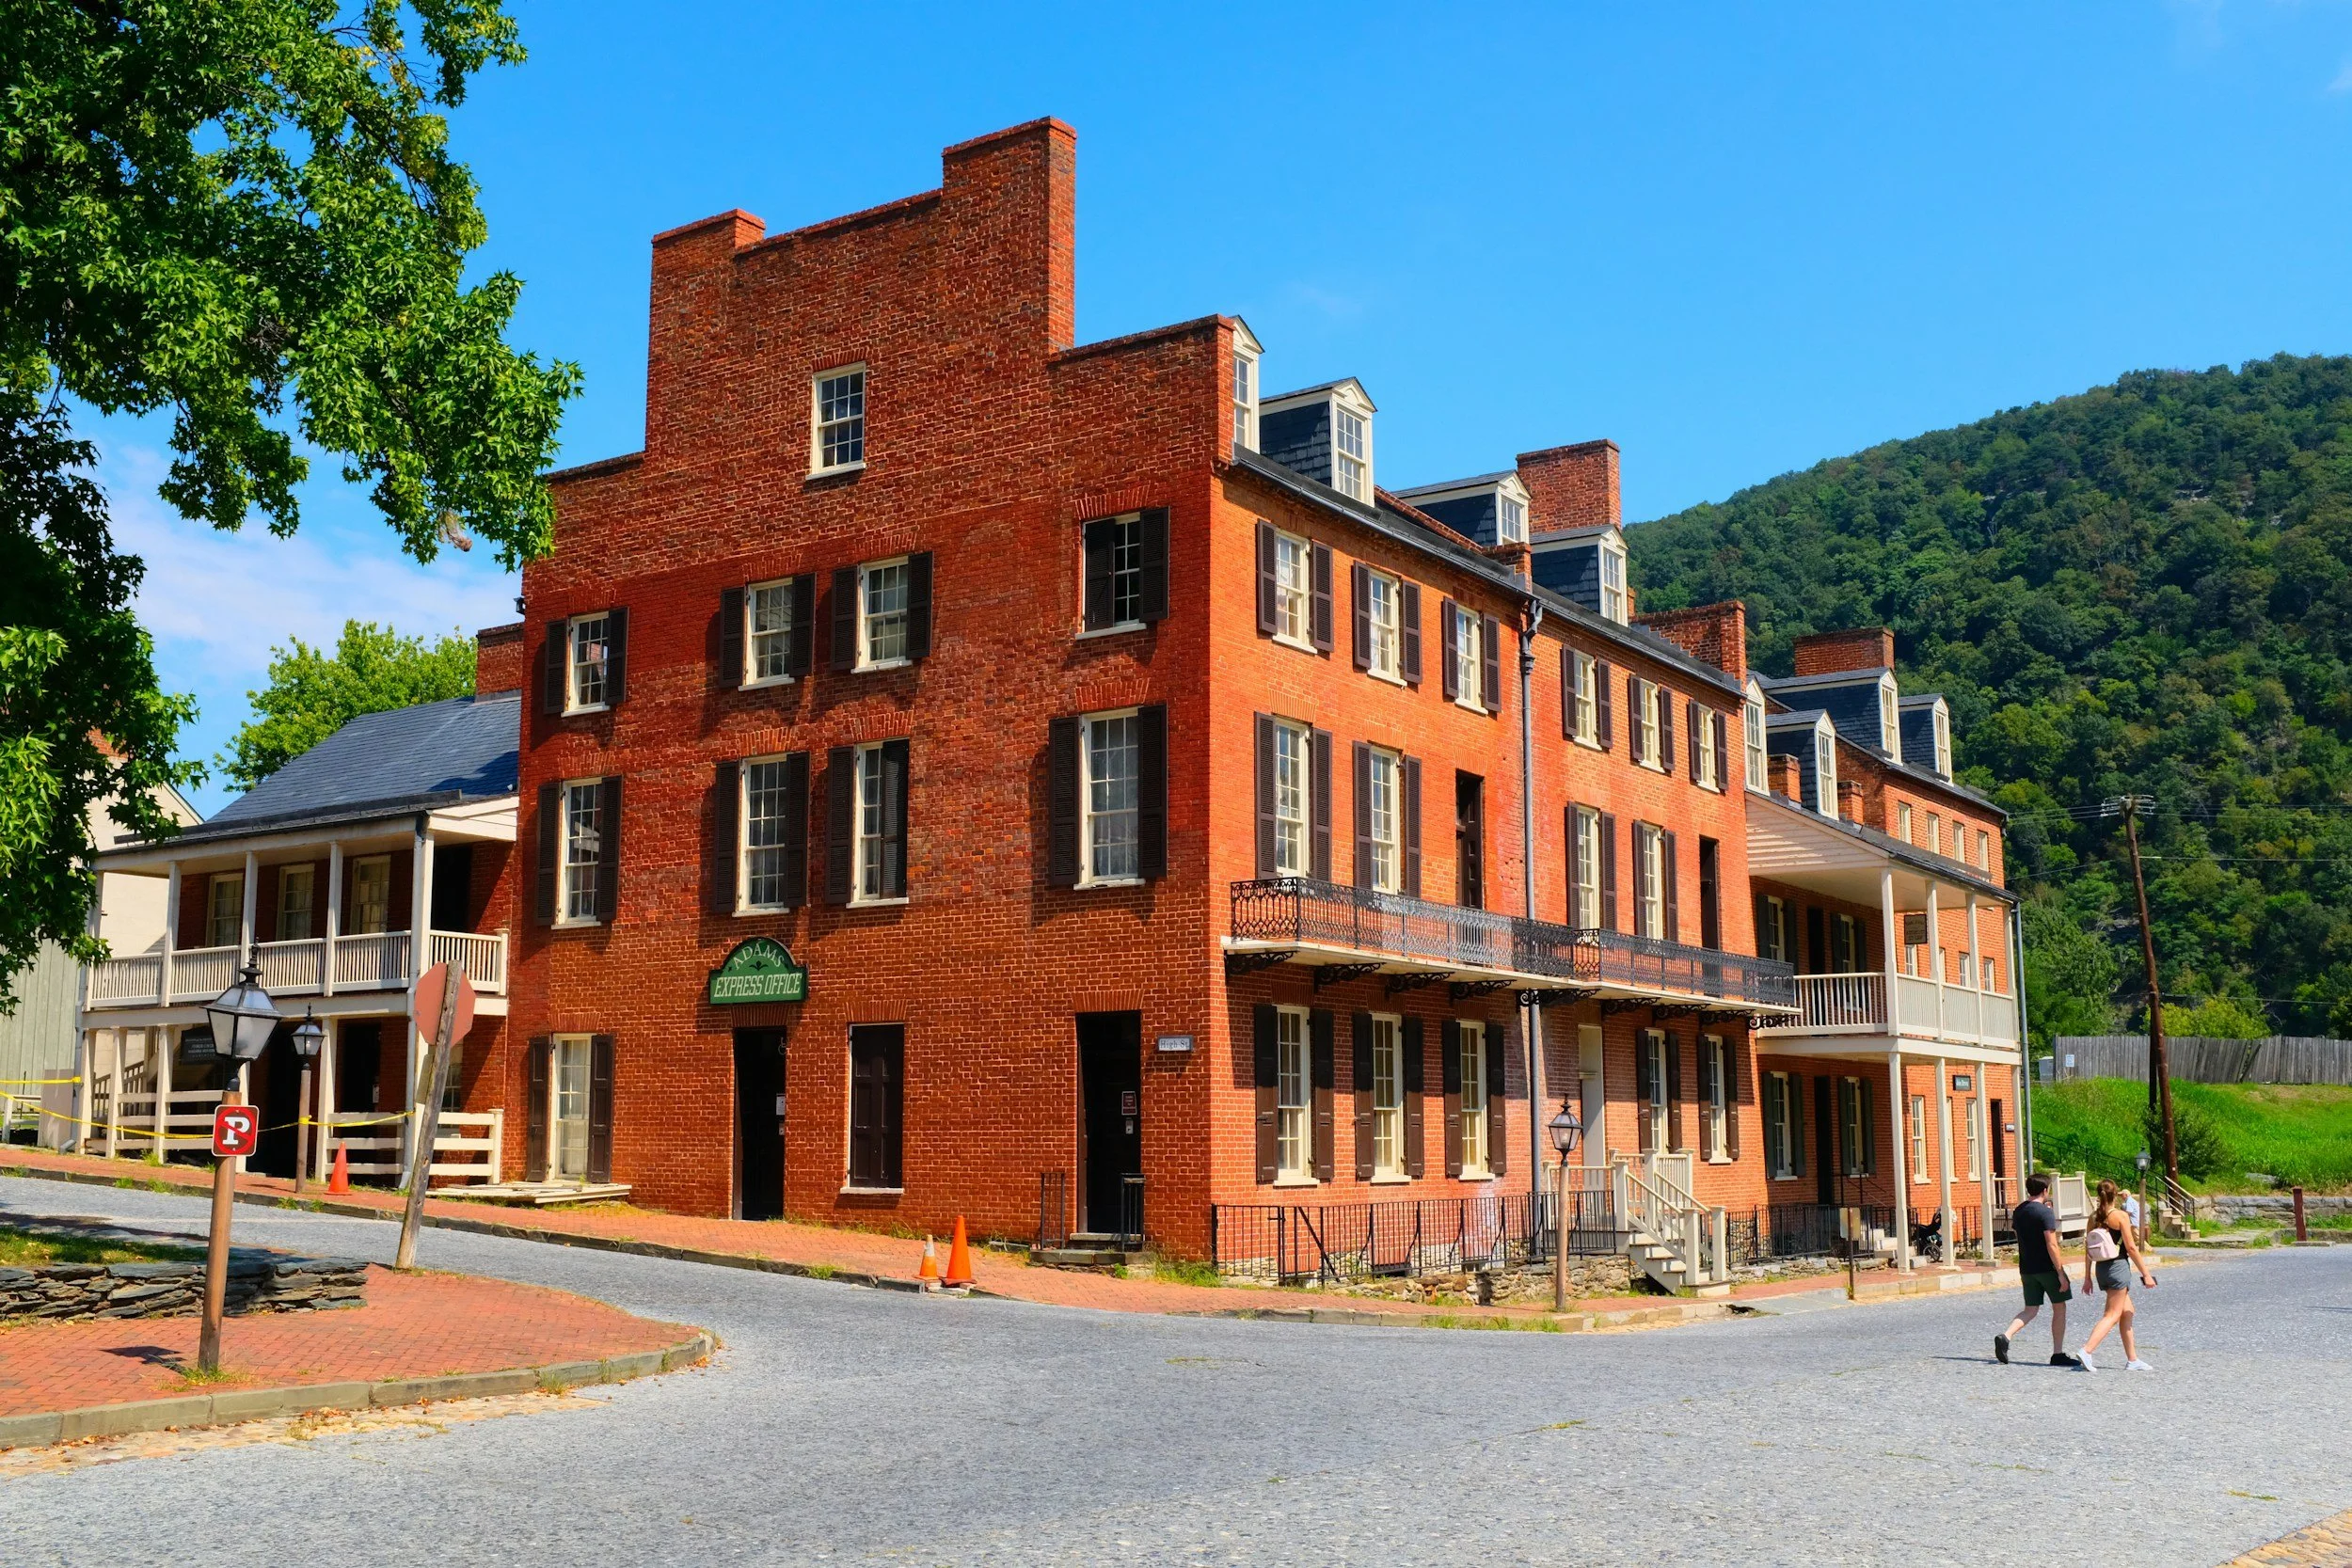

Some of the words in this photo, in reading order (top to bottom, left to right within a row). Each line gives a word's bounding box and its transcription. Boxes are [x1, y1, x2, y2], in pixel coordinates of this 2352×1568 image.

[733, 943, 784, 970] ADAMS
[714, 975, 763, 997] EXPRESS
[765, 974, 803, 994] OFFICE
[1160, 1039, 1178, 1050] High
[222, 1117, 250, 1145] P
